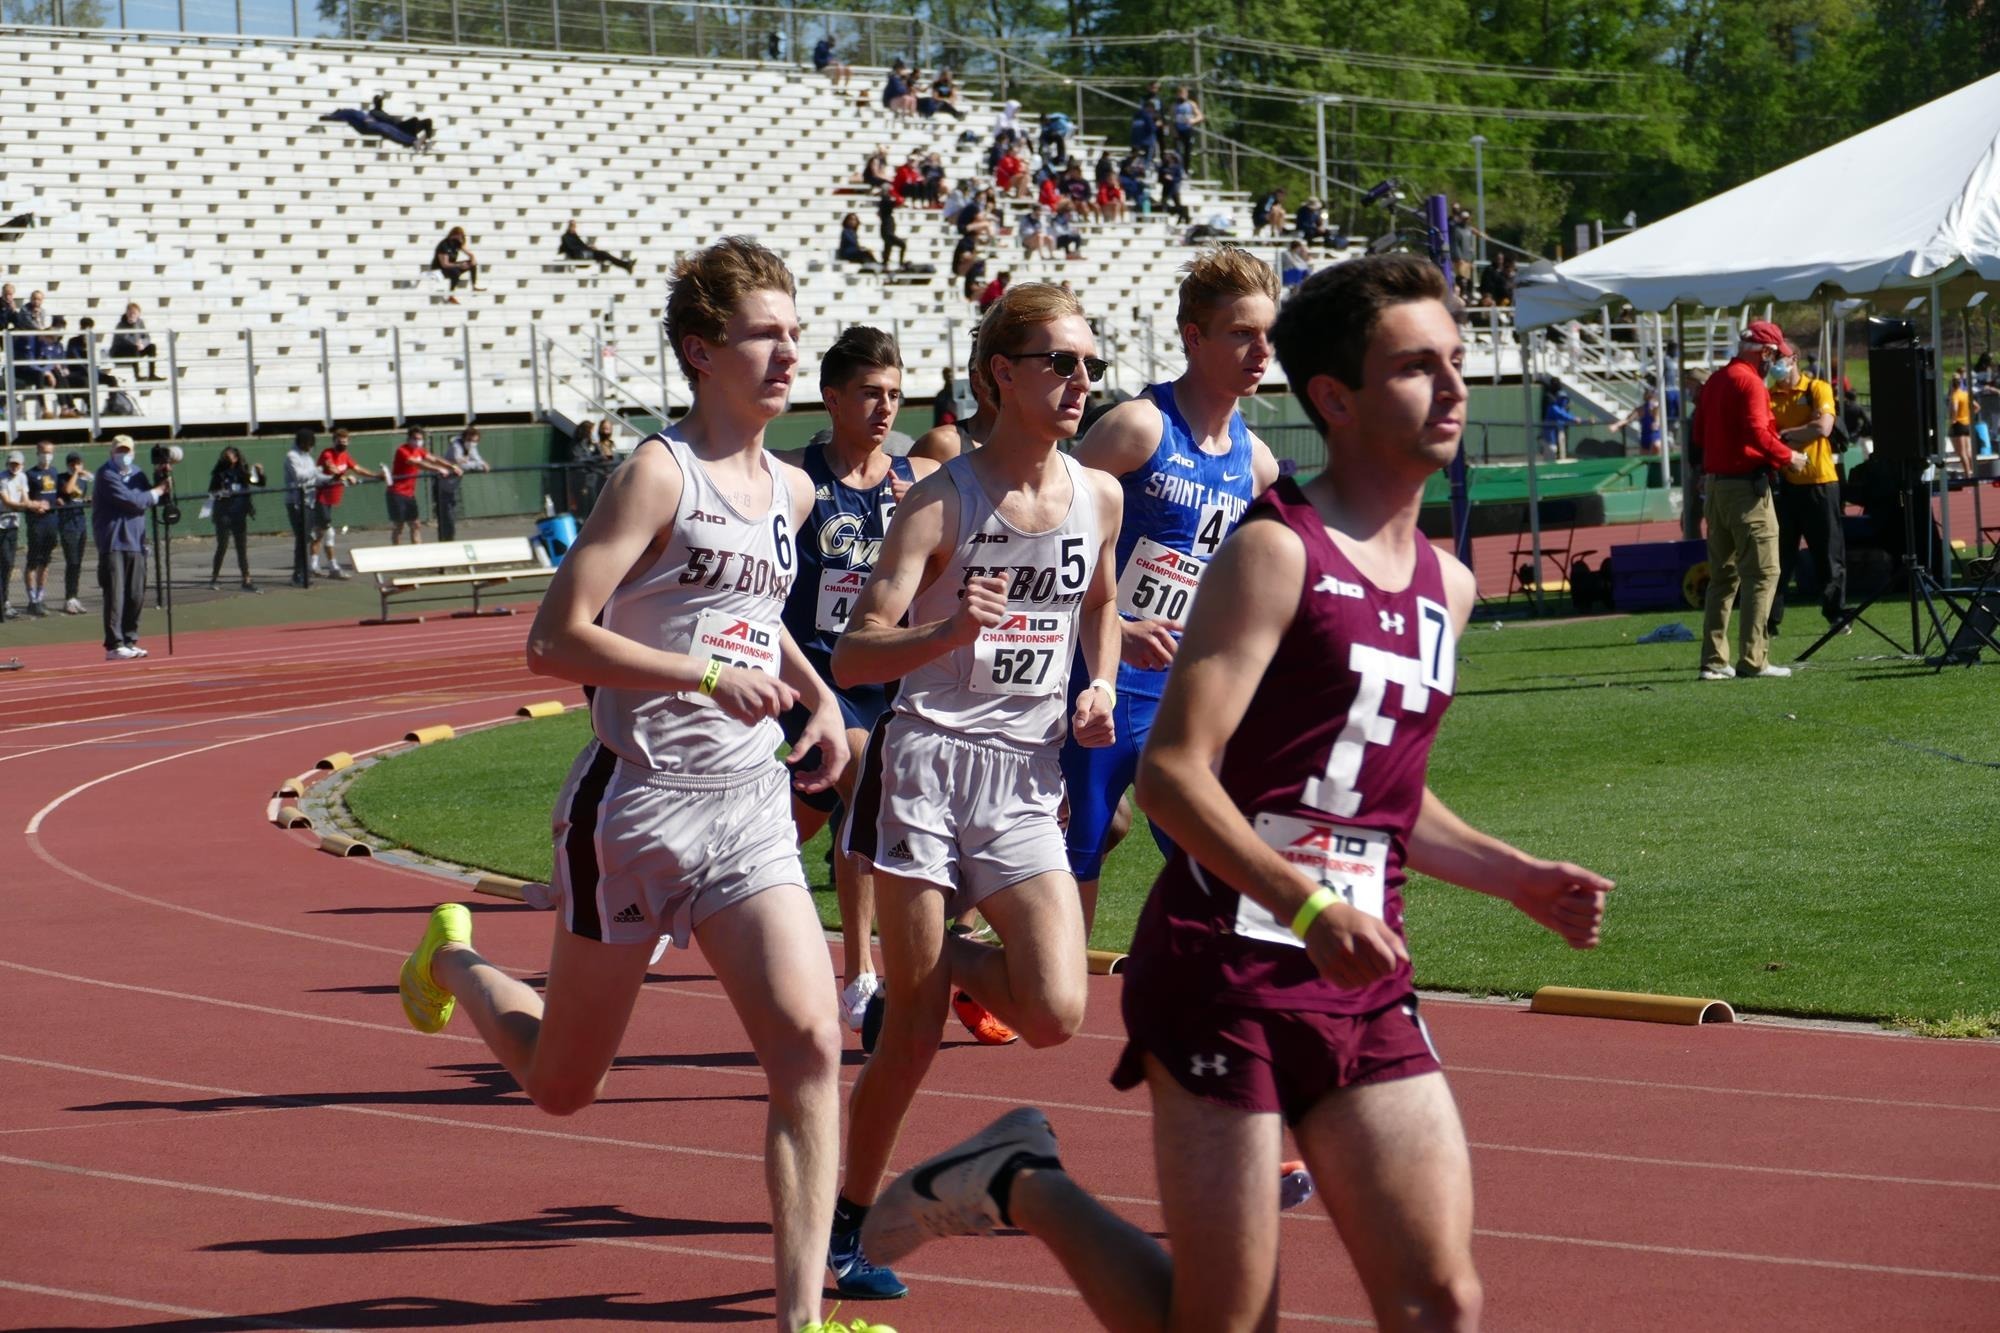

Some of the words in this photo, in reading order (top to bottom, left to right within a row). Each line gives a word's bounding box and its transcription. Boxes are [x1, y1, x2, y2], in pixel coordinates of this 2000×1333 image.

[1167, 453, 1195, 468] A10
[1144, 472, 1205, 510] SAINT
[685, 510, 726, 525] A10
[1198, 510, 1225, 553] 4
[772, 514, 792, 570] 6
[968, 533, 1009, 545] A10
[1061, 537, 1086, 589] 5
[1136, 557, 1200, 588] CHAMPIONSHIP
[1153, 550, 1200, 576] A10
[1131, 574, 1188, 621] 510
[720, 619, 770, 647] A10
[982, 633, 1064, 643] CHAMPIONSHIPS
[999, 615, 1058, 631] A10
[701, 634, 774, 662] CHAMPIONSHIPS
[1424, 606, 1444, 681] 7
[992, 648, 1054, 685] 527
[1290, 825, 1367, 857] A10
